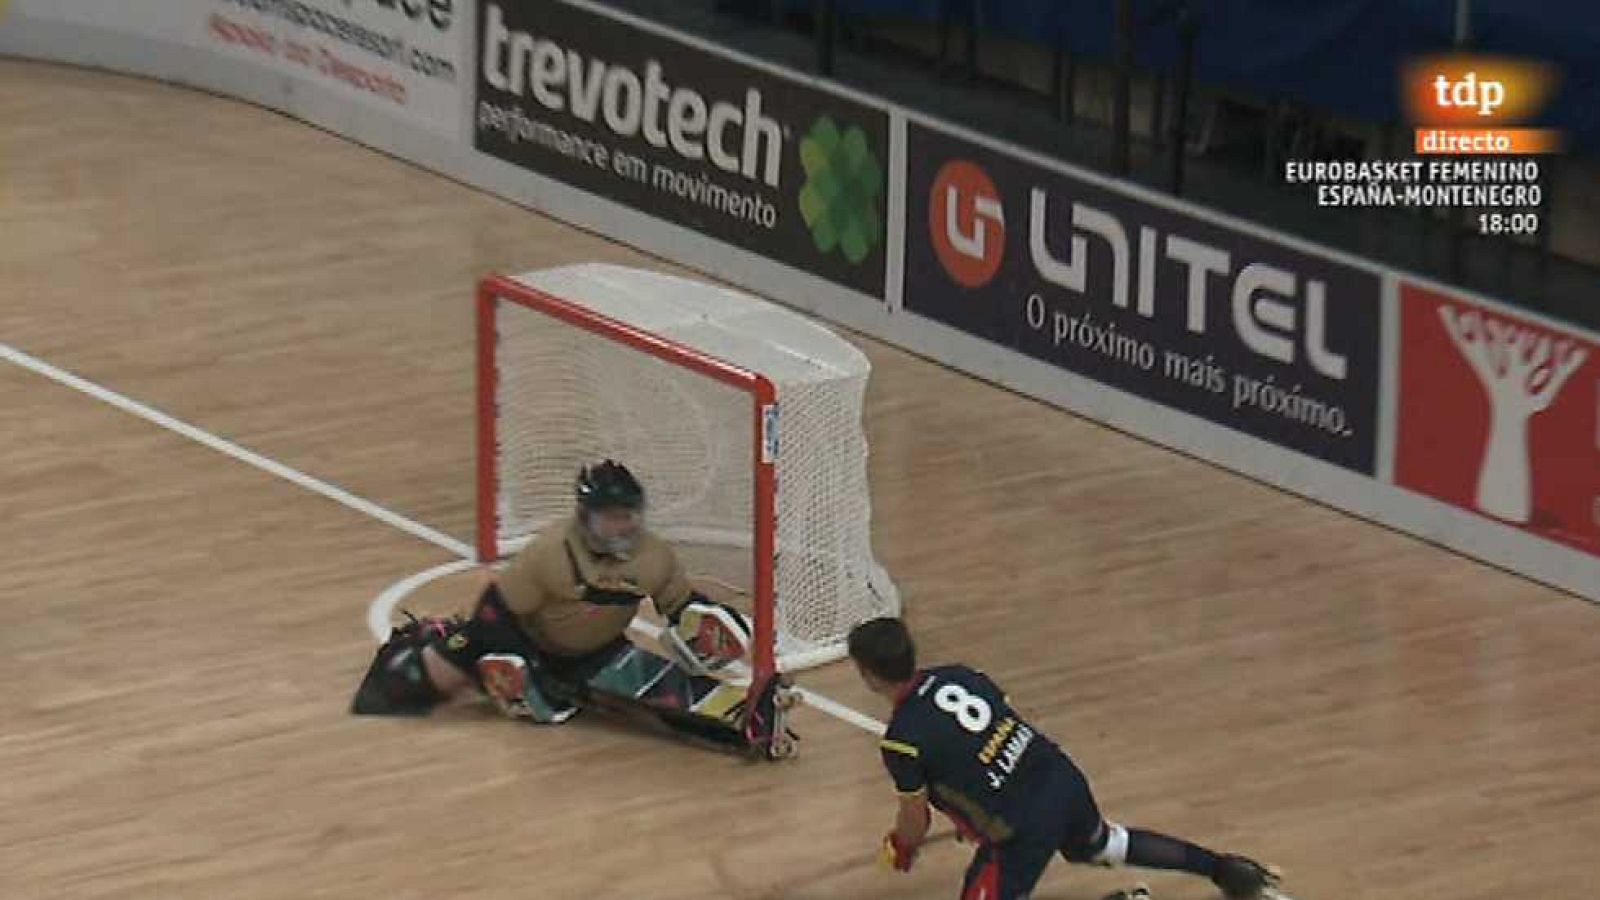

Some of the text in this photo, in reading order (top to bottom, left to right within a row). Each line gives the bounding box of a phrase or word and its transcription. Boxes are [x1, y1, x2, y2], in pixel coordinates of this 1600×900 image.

[479, 101, 776, 230] performance em movimento
[484, 4, 783, 188] trevotech
[1029, 187, 1347, 380] UNITEL
[1026, 294, 1354, 437] O próximo mais próximo.
[934, 684, 992, 732] 8
